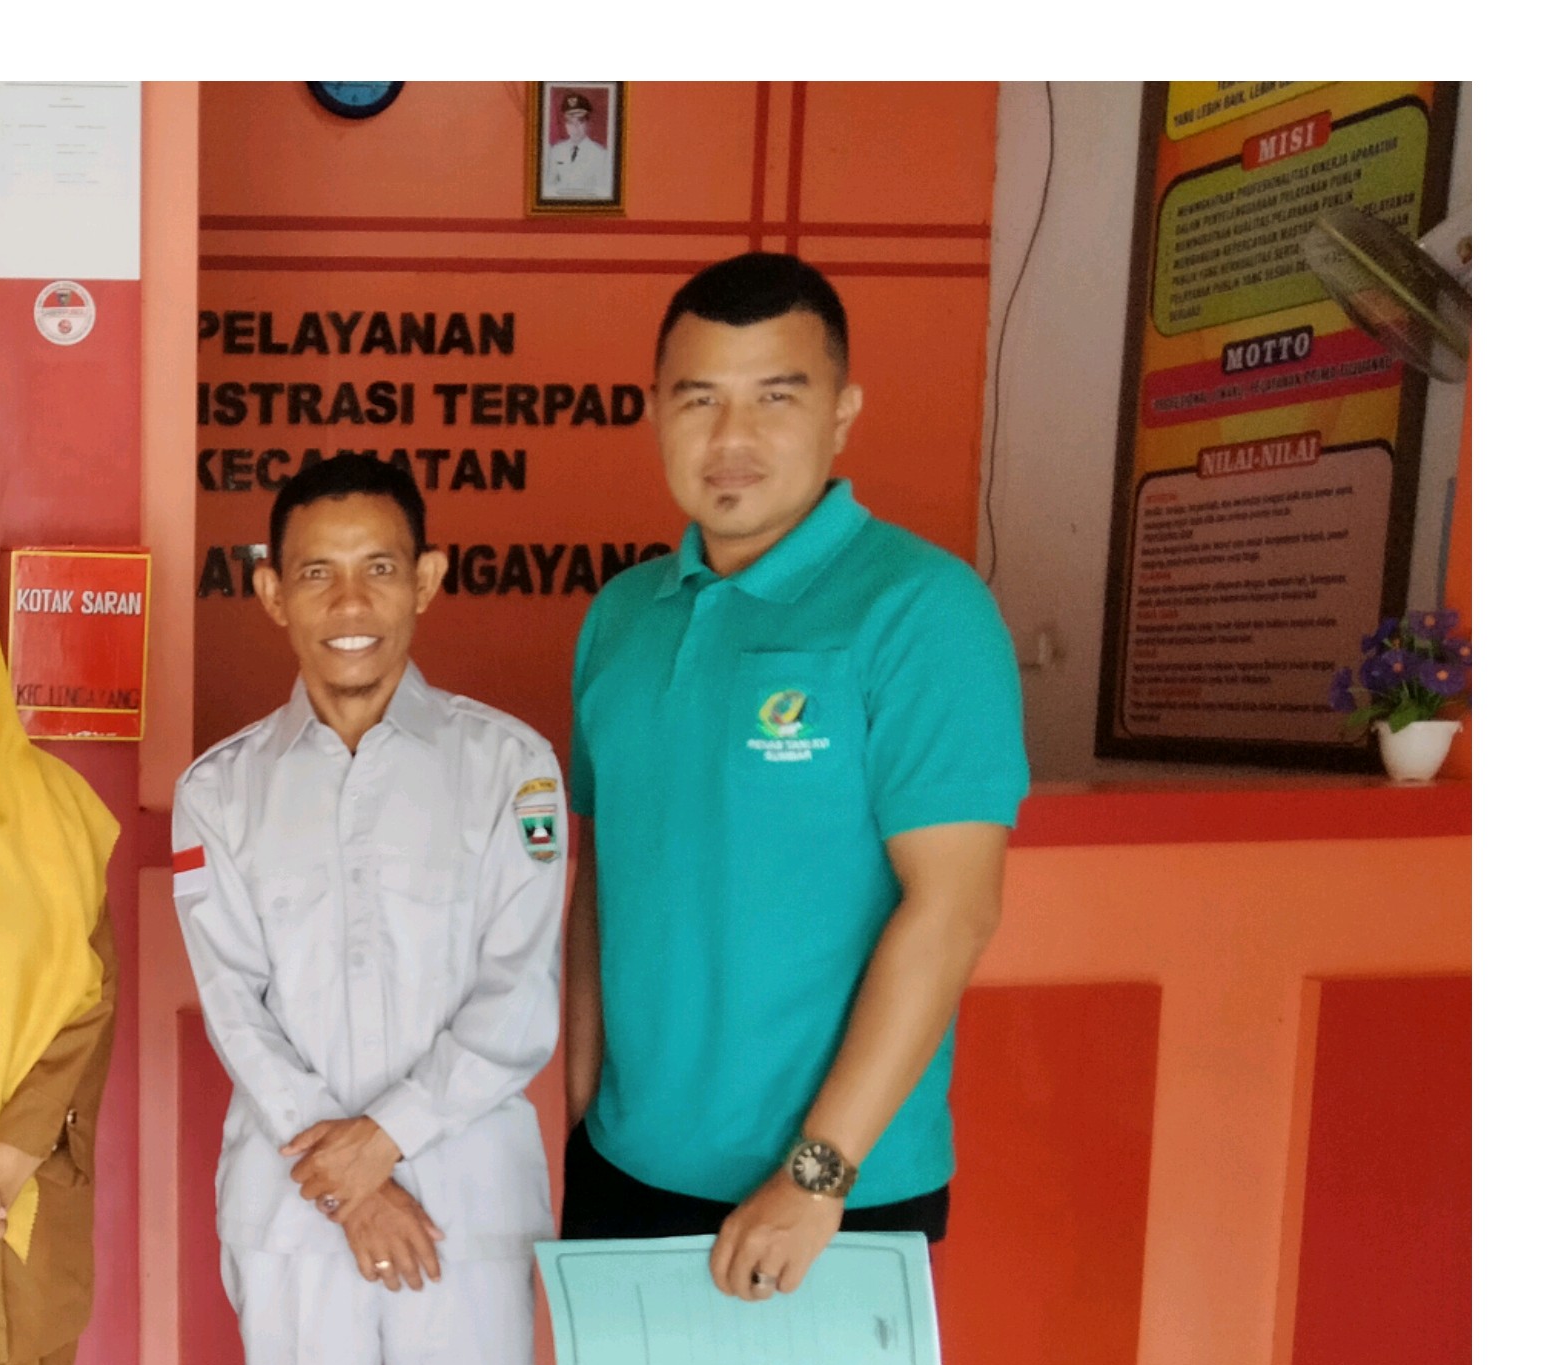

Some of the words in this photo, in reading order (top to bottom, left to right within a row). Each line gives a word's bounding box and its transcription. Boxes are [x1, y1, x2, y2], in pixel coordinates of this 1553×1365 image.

[1257, 121, 1316, 163] MISI
[1225, 331, 1310, 371] MOTTO
[197, 381, 415, 427] ISTRASI
[434, 382, 645, 427] TERPAD
[1200, 436, 1318, 476] NILAI-NILAI
[16, 588, 75, 614] KOTAK
[81, 590, 142, 616] SARAN
